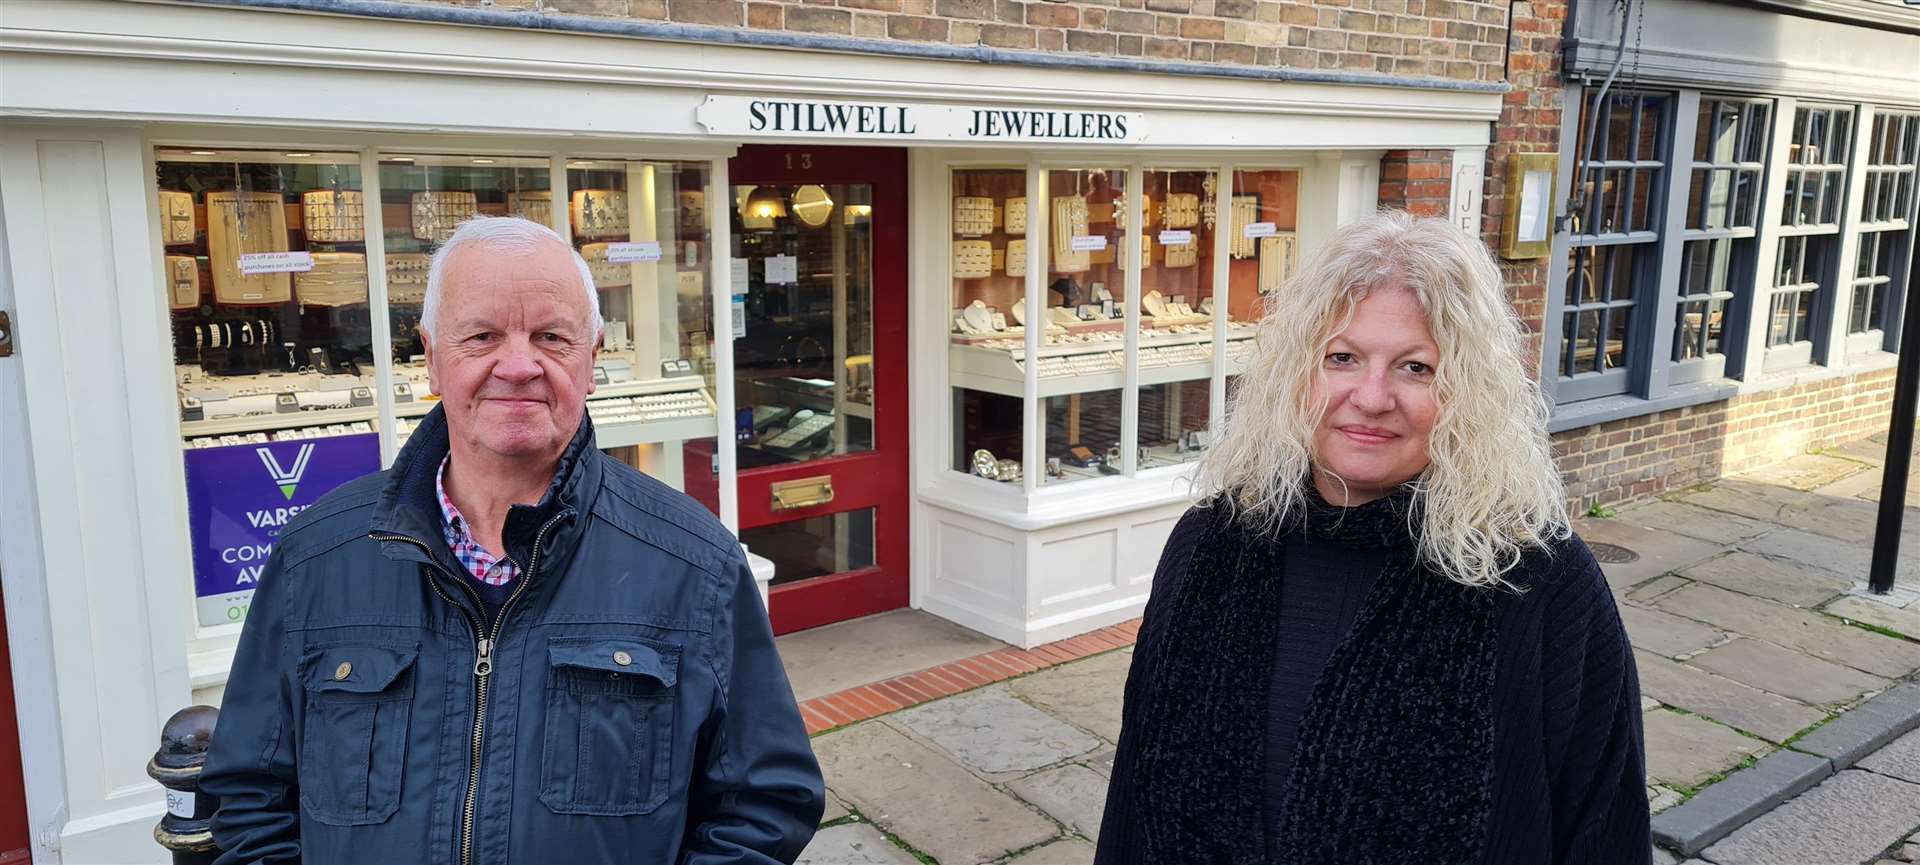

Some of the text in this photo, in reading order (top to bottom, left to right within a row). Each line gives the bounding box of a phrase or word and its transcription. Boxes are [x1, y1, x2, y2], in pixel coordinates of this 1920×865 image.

[749, 100, 1127, 140] STILWELL JEWELLERS
[785, 153, 812, 169] 13
[246, 504, 312, 528] VARS
[267, 529, 281, 537] CA
